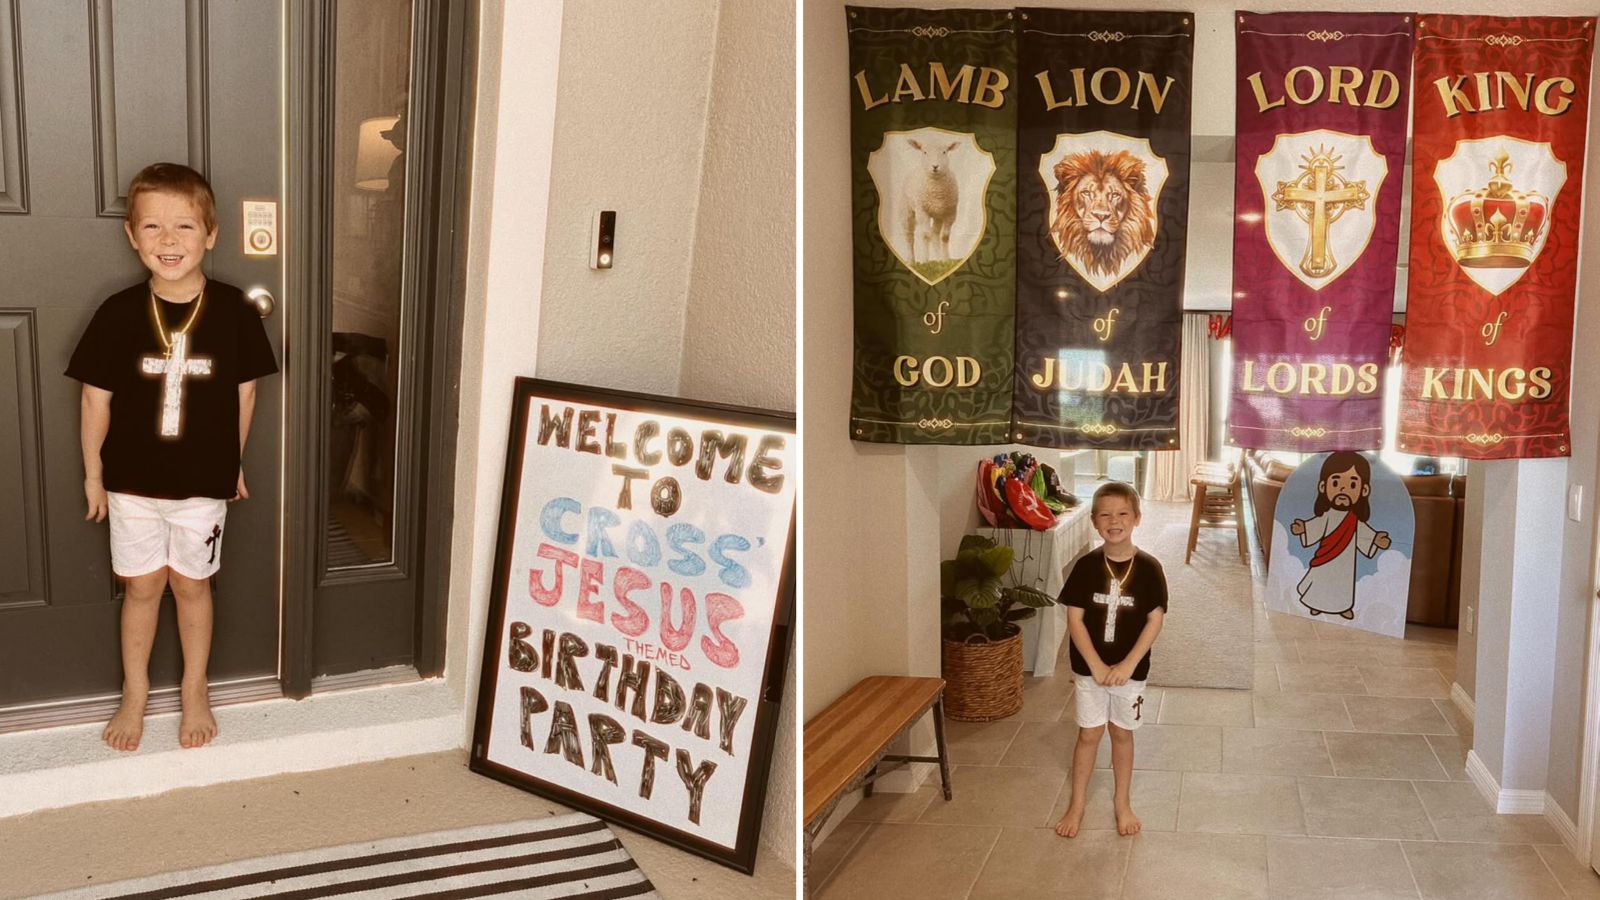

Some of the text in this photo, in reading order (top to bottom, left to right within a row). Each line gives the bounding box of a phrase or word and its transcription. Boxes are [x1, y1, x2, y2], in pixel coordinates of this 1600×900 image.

[854, 61, 1010, 111] LAMB
[1034, 66, 1176, 114] LION
[1246, 65, 1401, 113] LORD
[1433, 70, 1577, 118] KING
[923, 301, 950, 334] of
[1093, 308, 1120, 341] of
[1304, 306, 1332, 341] of
[1481, 311, 1508, 346] of
[893, 355, 982, 387] GOD
[1032, 357, 1169, 393] JUDAH
[1241, 360, 1380, 395] LORDS
[1421, 366, 1554, 400] KINGS
[536, 403, 787, 494] WELCOME
[611, 464, 683, 518] TO
[528, 542, 744, 670] JESUS
[623, 637, 691, 671] THEMED
[507, 620, 748, 757] BIRTHDAY
[519, 685, 719, 826] PARTY
